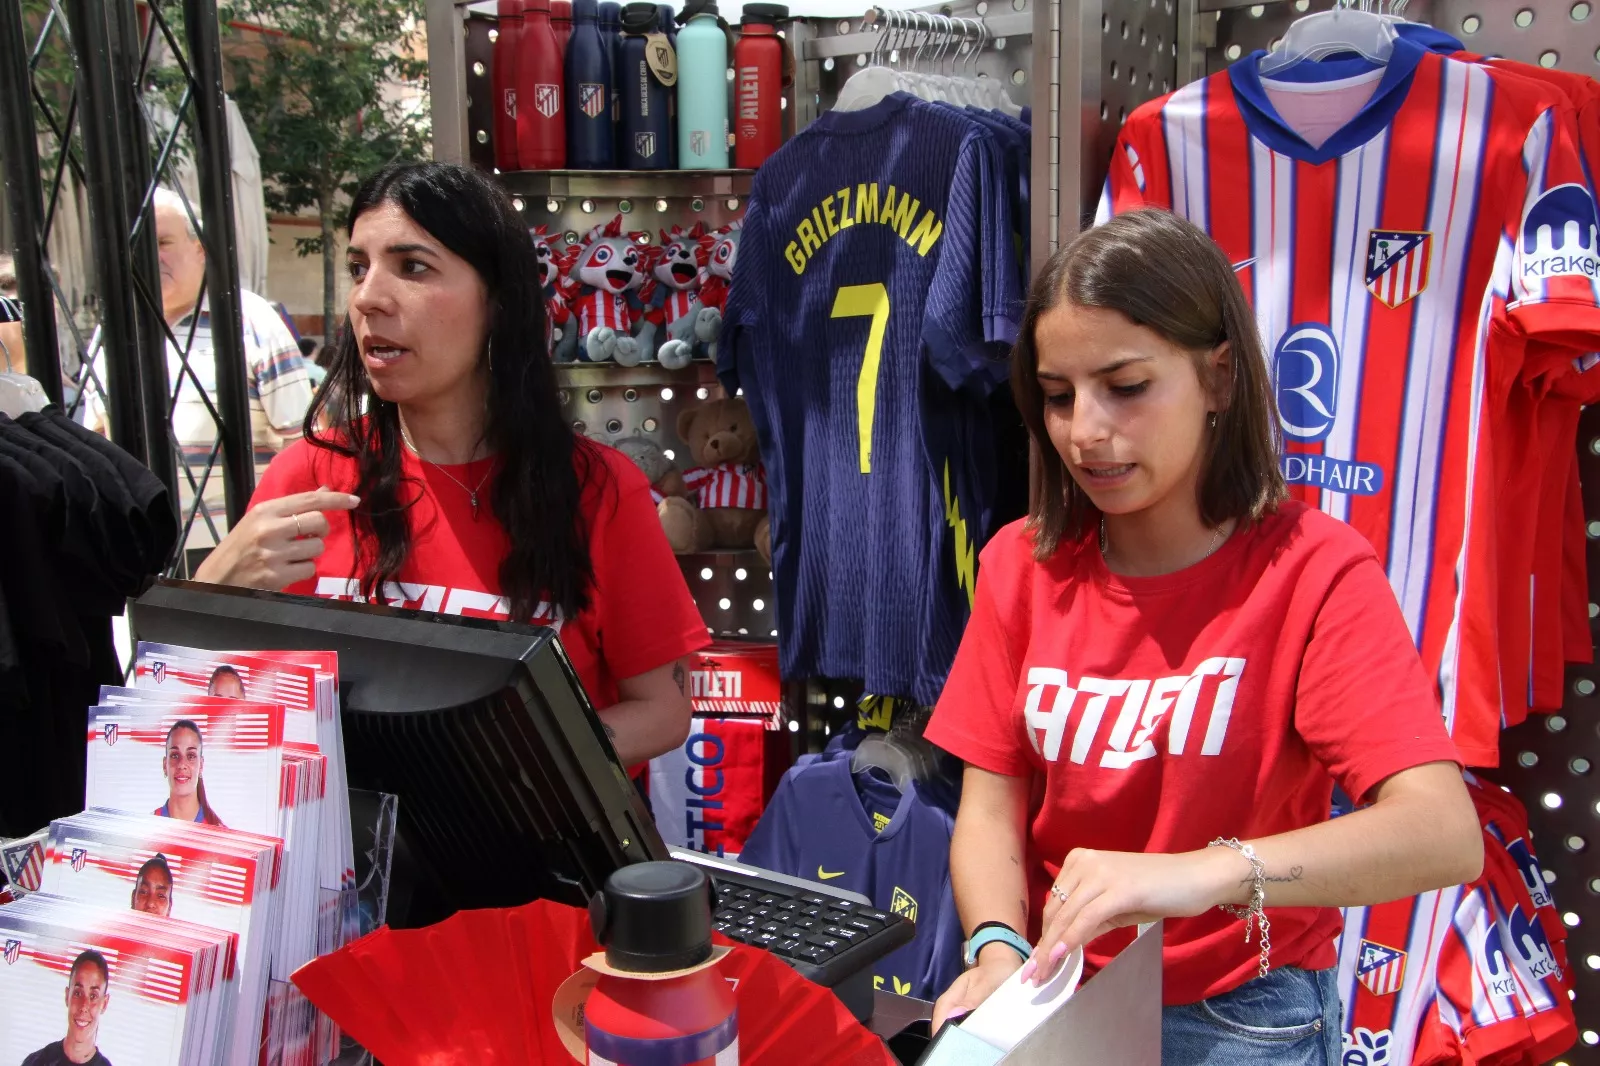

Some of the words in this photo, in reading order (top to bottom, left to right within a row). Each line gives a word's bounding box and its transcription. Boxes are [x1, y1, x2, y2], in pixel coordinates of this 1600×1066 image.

[740, 66, 759, 119] ATLETI
[785, 183, 943, 275] GRIEZMANN
[830, 283, 890, 473] 7
[690, 671, 742, 698] TLETI
[1024, 657, 1247, 769] ATLETI
